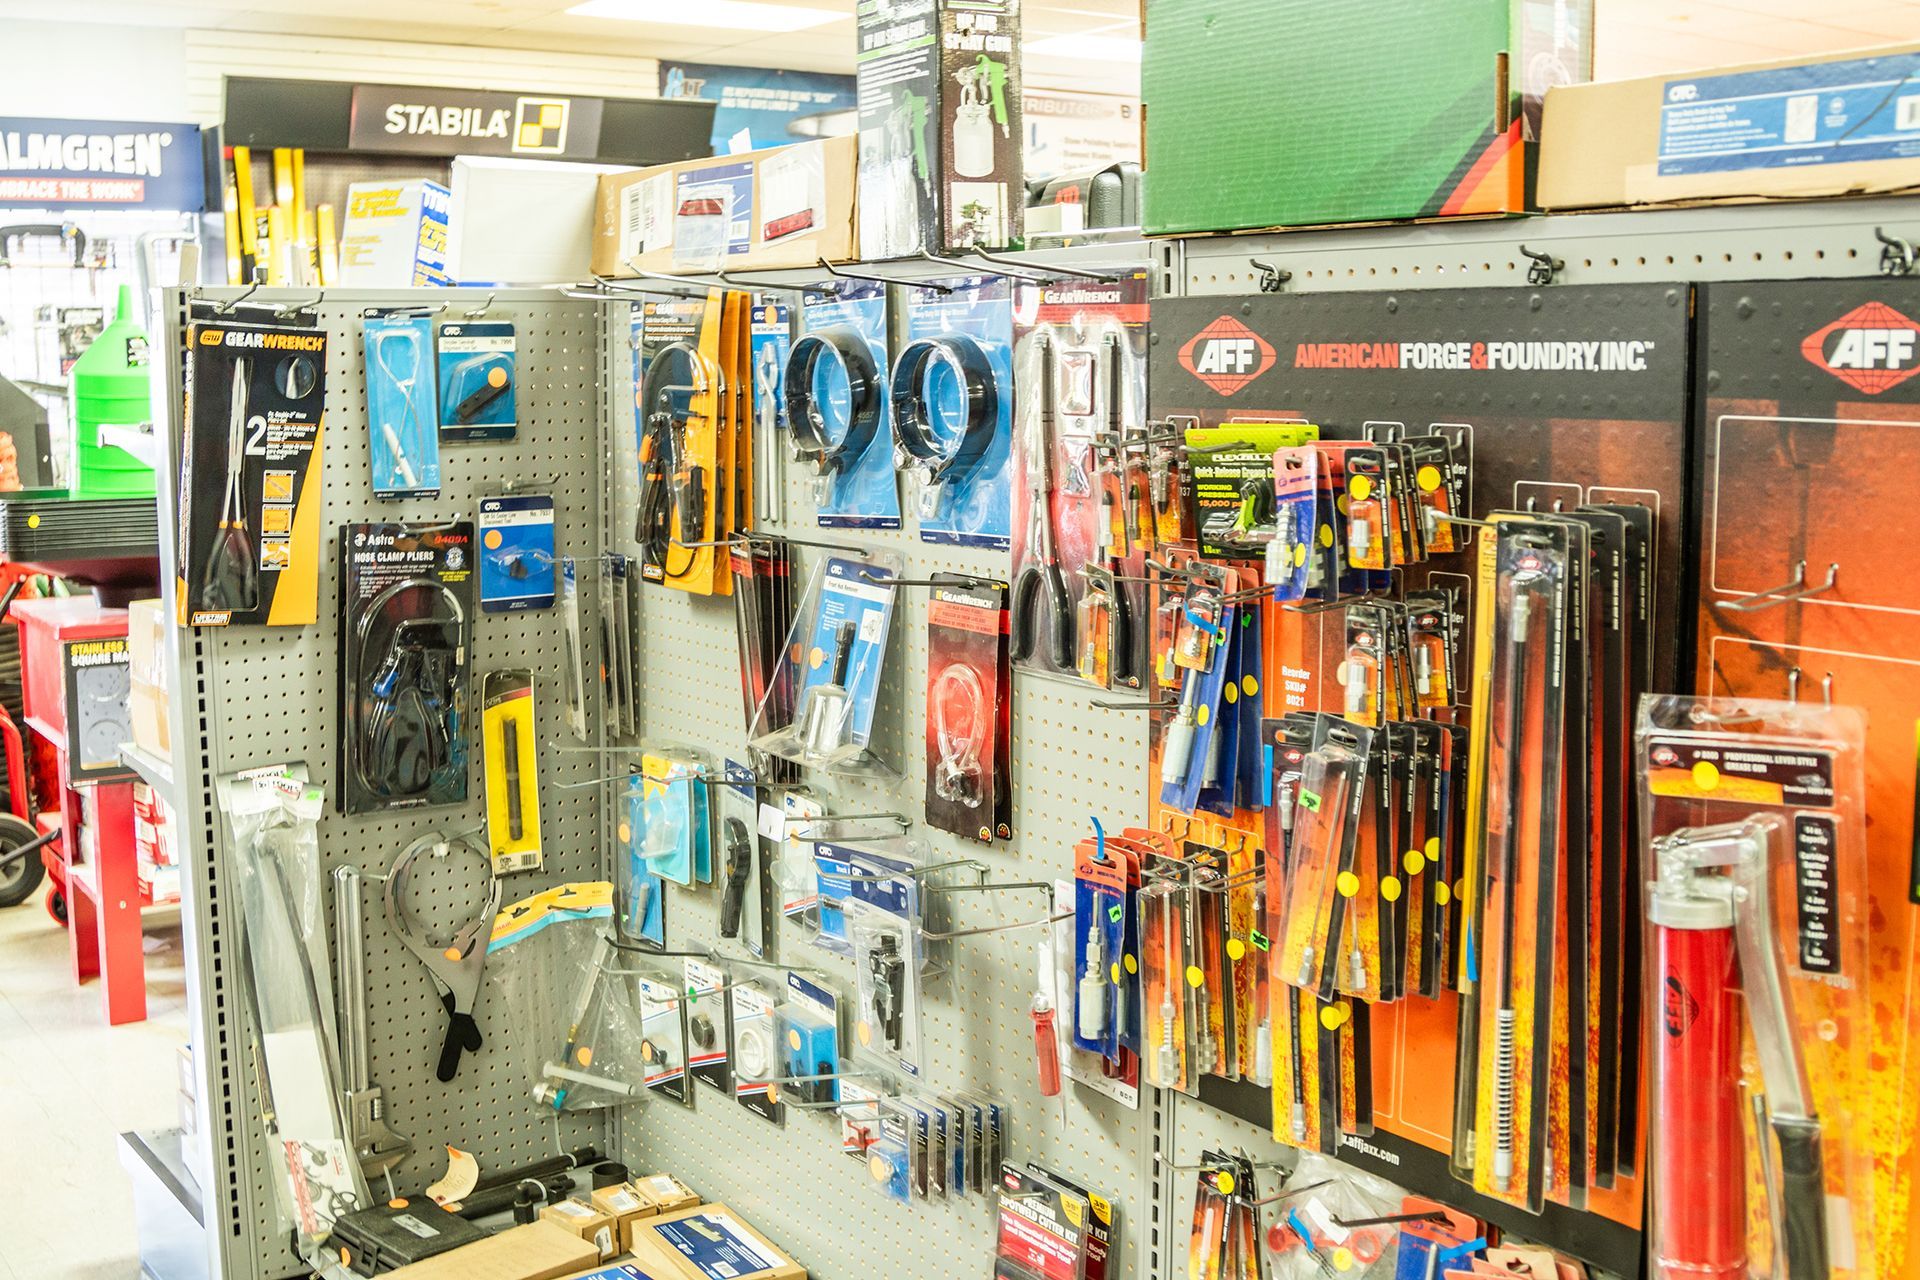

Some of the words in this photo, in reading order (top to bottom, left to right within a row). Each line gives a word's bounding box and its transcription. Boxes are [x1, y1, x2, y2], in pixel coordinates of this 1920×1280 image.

[384, 103, 509, 139] STABILA
[60, 181, 89, 199] THE
[92, 183, 135, 200] WORK
[1044, 290, 1120, 304] GEARWRENCH
[444, 326, 462, 336] OTC
[226, 331, 324, 351] GEARWRENCH
[1197, 338, 1254, 373] AFF
[1295, 343, 1399, 369] AMERICAN
[1400, 343, 1470, 370] FORGE
[1827, 329, 1916, 369] AFF
[246, 415, 267, 456] 2
[485, 502, 501, 511] OTC
[1199, 500, 1230, 508] 15,000
[367, 534, 395, 546] Astro
[354, 552, 375, 563] HOSE
[377, 552, 405, 563] CLAMP
[407, 551, 434, 562] PLIERS
[71, 641, 123, 656] STAINLESS
[71, 653, 111, 667] SQUARE
[1282, 666, 1310, 680] Reorder
[1724, 752, 1773, 764] PROFESSIONAL
[1774, 755, 1796, 765] LEVER
[1797, 756, 1818, 767] STYLE
[1724, 762, 1751, 772] GREASE
[1023, 1197, 1056, 1221] PREMIUM
[1000, 1195, 1038, 1222] SPOTWELD
[1039, 1215, 1065, 1238] CUTTER
[1065, 1228, 1079, 1245] KIT
[1001, 1212, 1013, 1225] The
[1059, 1245, 1077, 1261] Body
[1095, 1227, 1108, 1242] KIT
[1057, 1251, 1072, 1265] Tool
